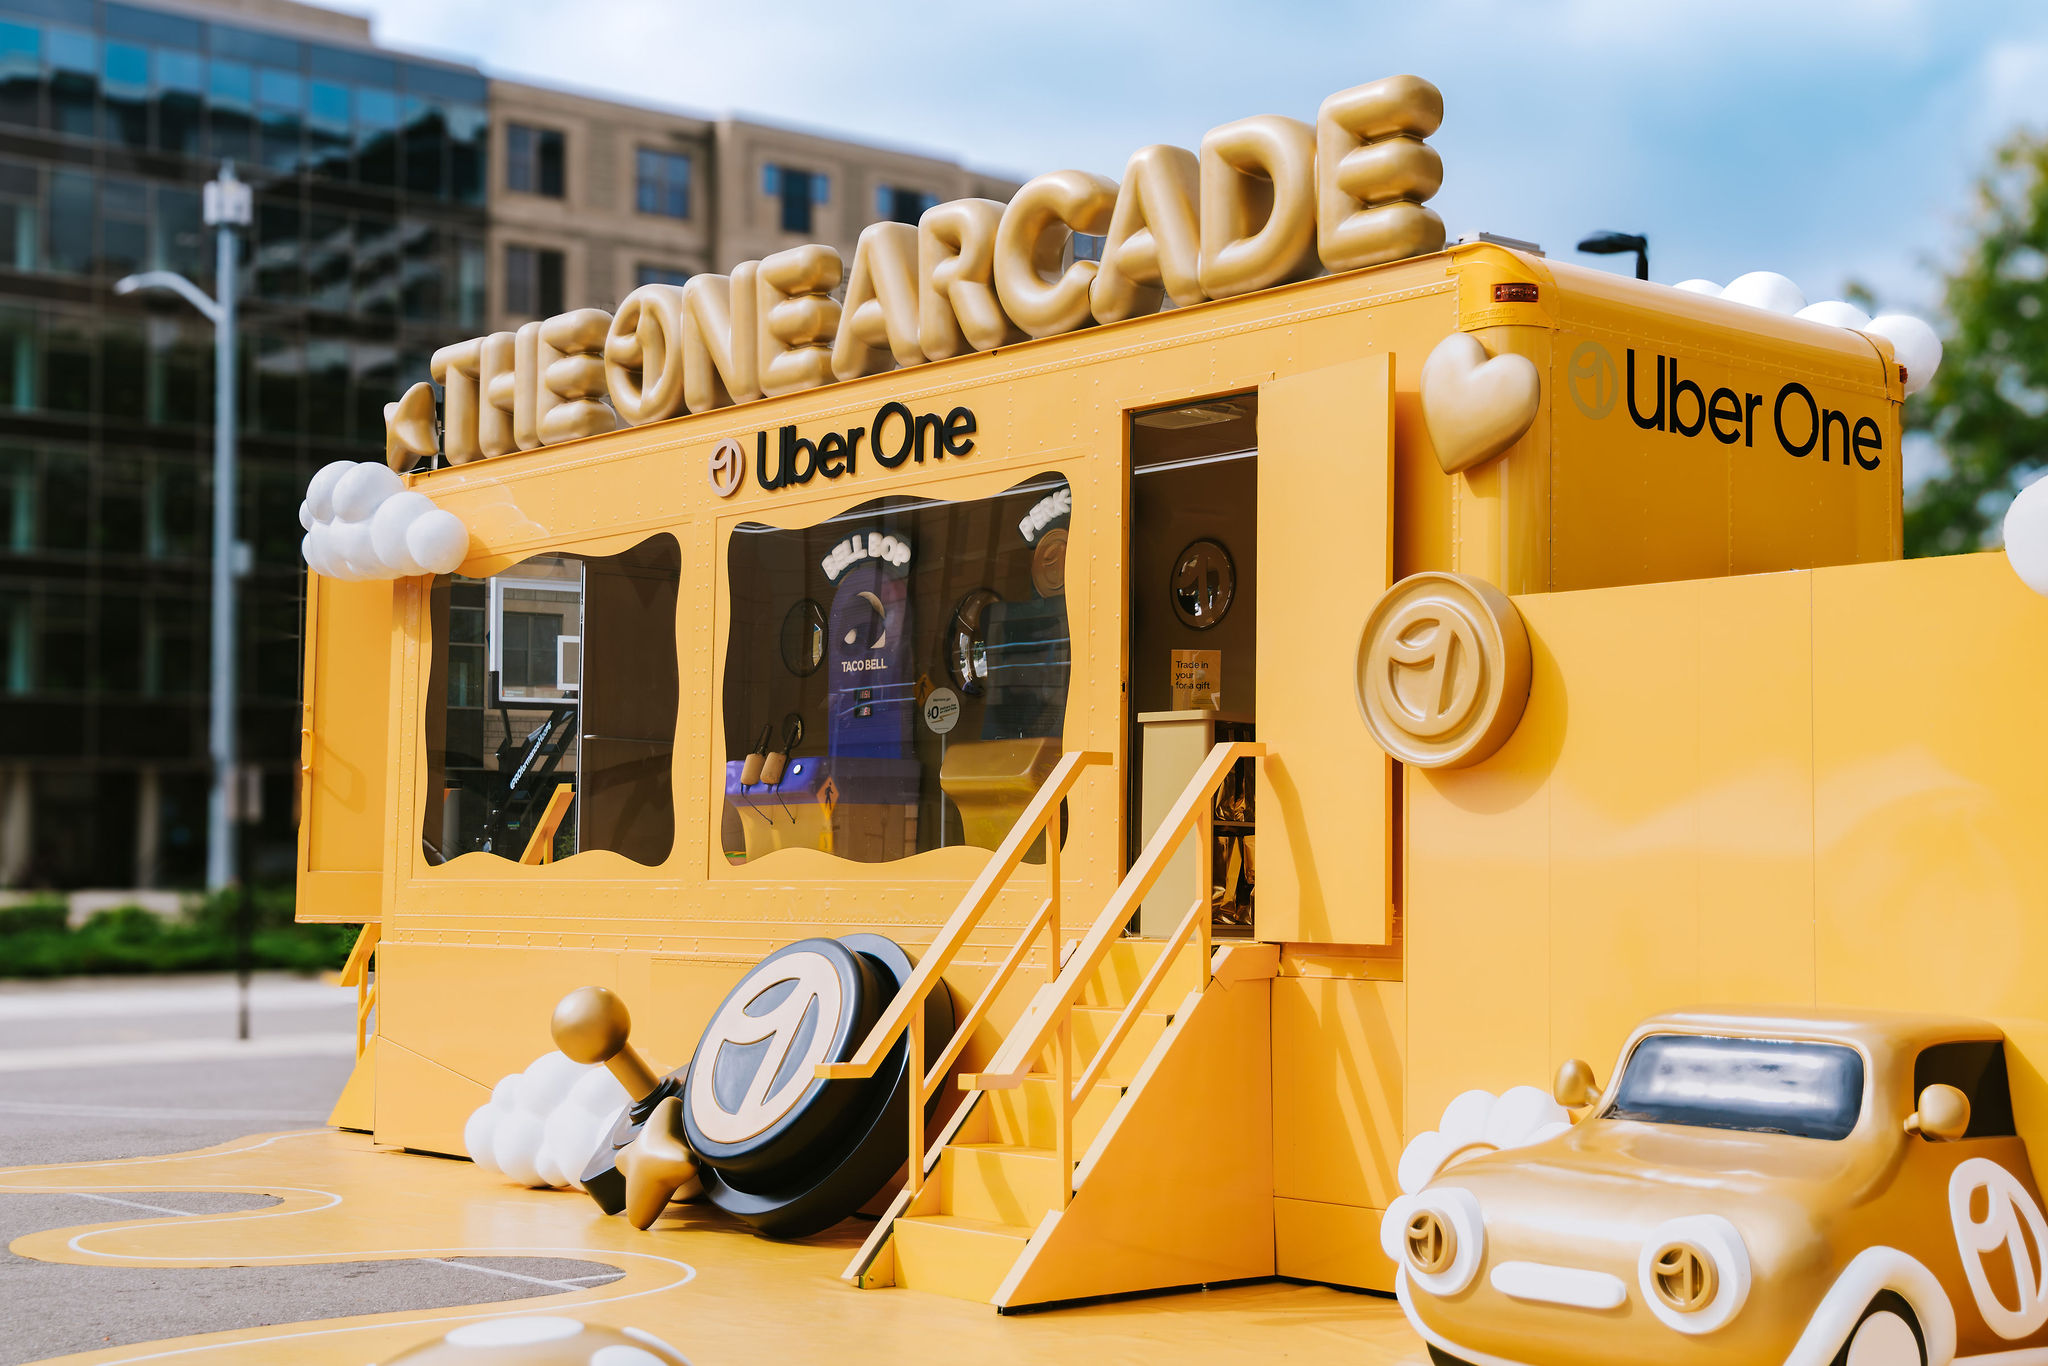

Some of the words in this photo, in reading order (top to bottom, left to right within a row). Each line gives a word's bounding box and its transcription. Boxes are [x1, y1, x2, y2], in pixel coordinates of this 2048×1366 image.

[431, 308, 617, 467] THE
[604, 244, 844, 427] ONE
[831, 74, 1447, 384] ARCADE
[1626, 348, 1763, 448] Uber
[1773, 382, 1883, 471] One
[756, 425, 866, 491] Uber
[870, 401, 977, 469] One
[821, 534, 868, 581] BELL
[868, 532, 911, 567] BOP
[841, 660, 865, 673] TACO
[865, 658, 888, 671] BELL
[1175, 660, 1200, 669] Trade
[1201, 660, 1209, 669] in
[1175, 672, 1194, 681] your
[1175, 681, 1187, 690] for
[1195, 681, 1211, 691] gift
